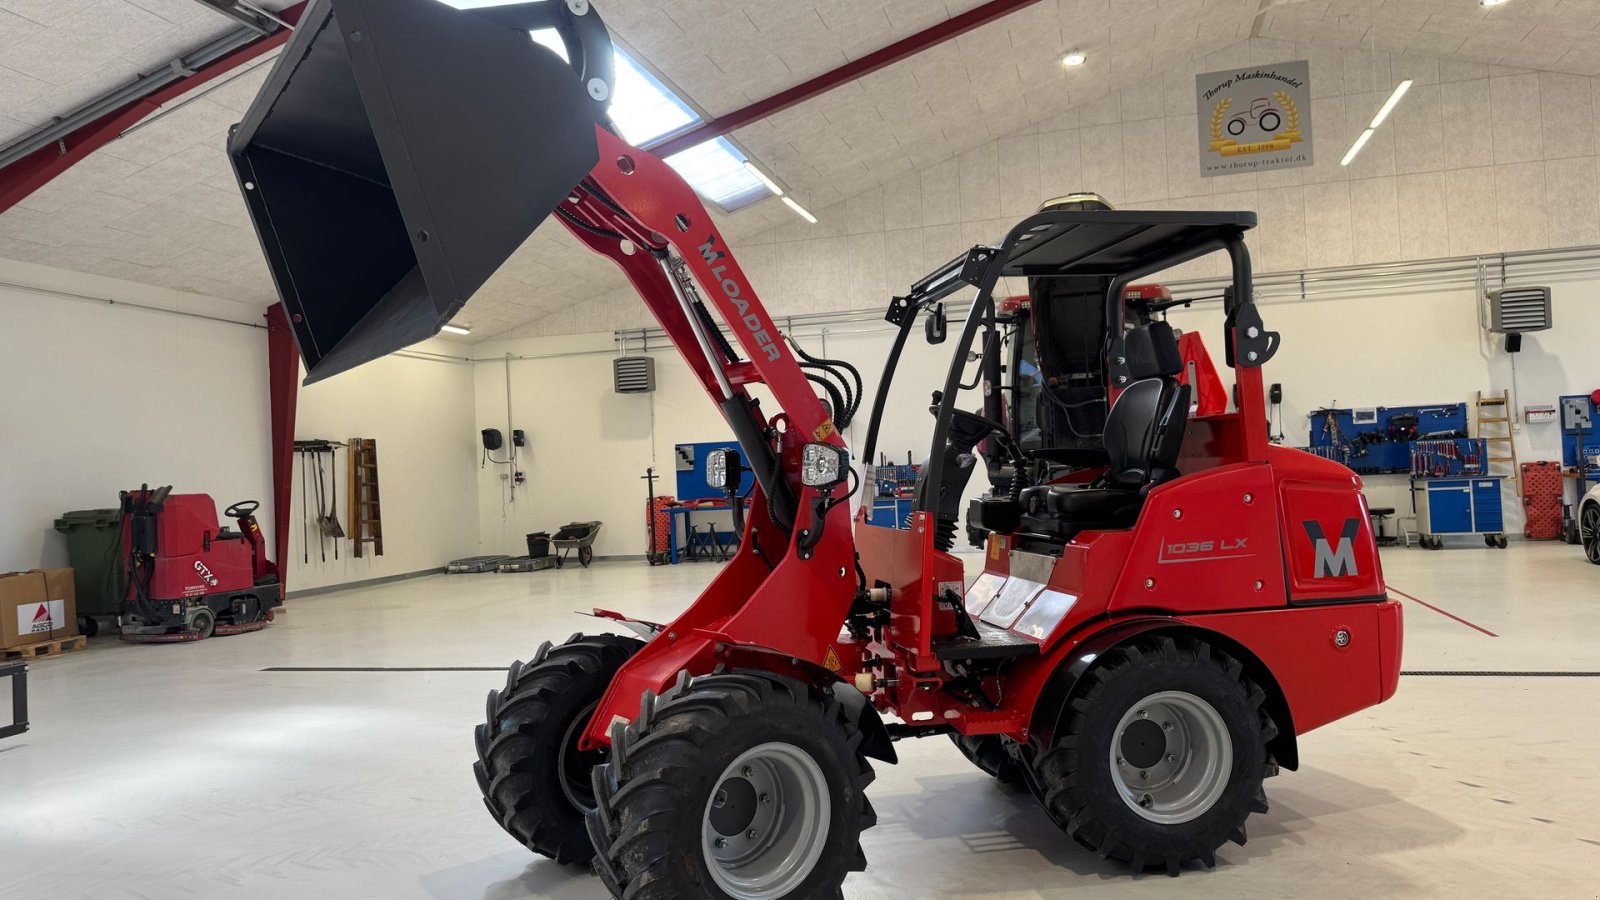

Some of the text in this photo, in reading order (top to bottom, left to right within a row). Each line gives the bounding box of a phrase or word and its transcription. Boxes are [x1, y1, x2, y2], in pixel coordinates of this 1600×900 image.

[1202, 70, 1303, 101] Thorup Maskinhandel
[1206, 154, 1308, 171] www.thorup-traktor.dk
[711, 265, 781, 362] LOADER
[1166, 537, 1249, 555] 1036 LX
[194, 560, 213, 582] GTX
[32, 621, 53, 629] AGCO
